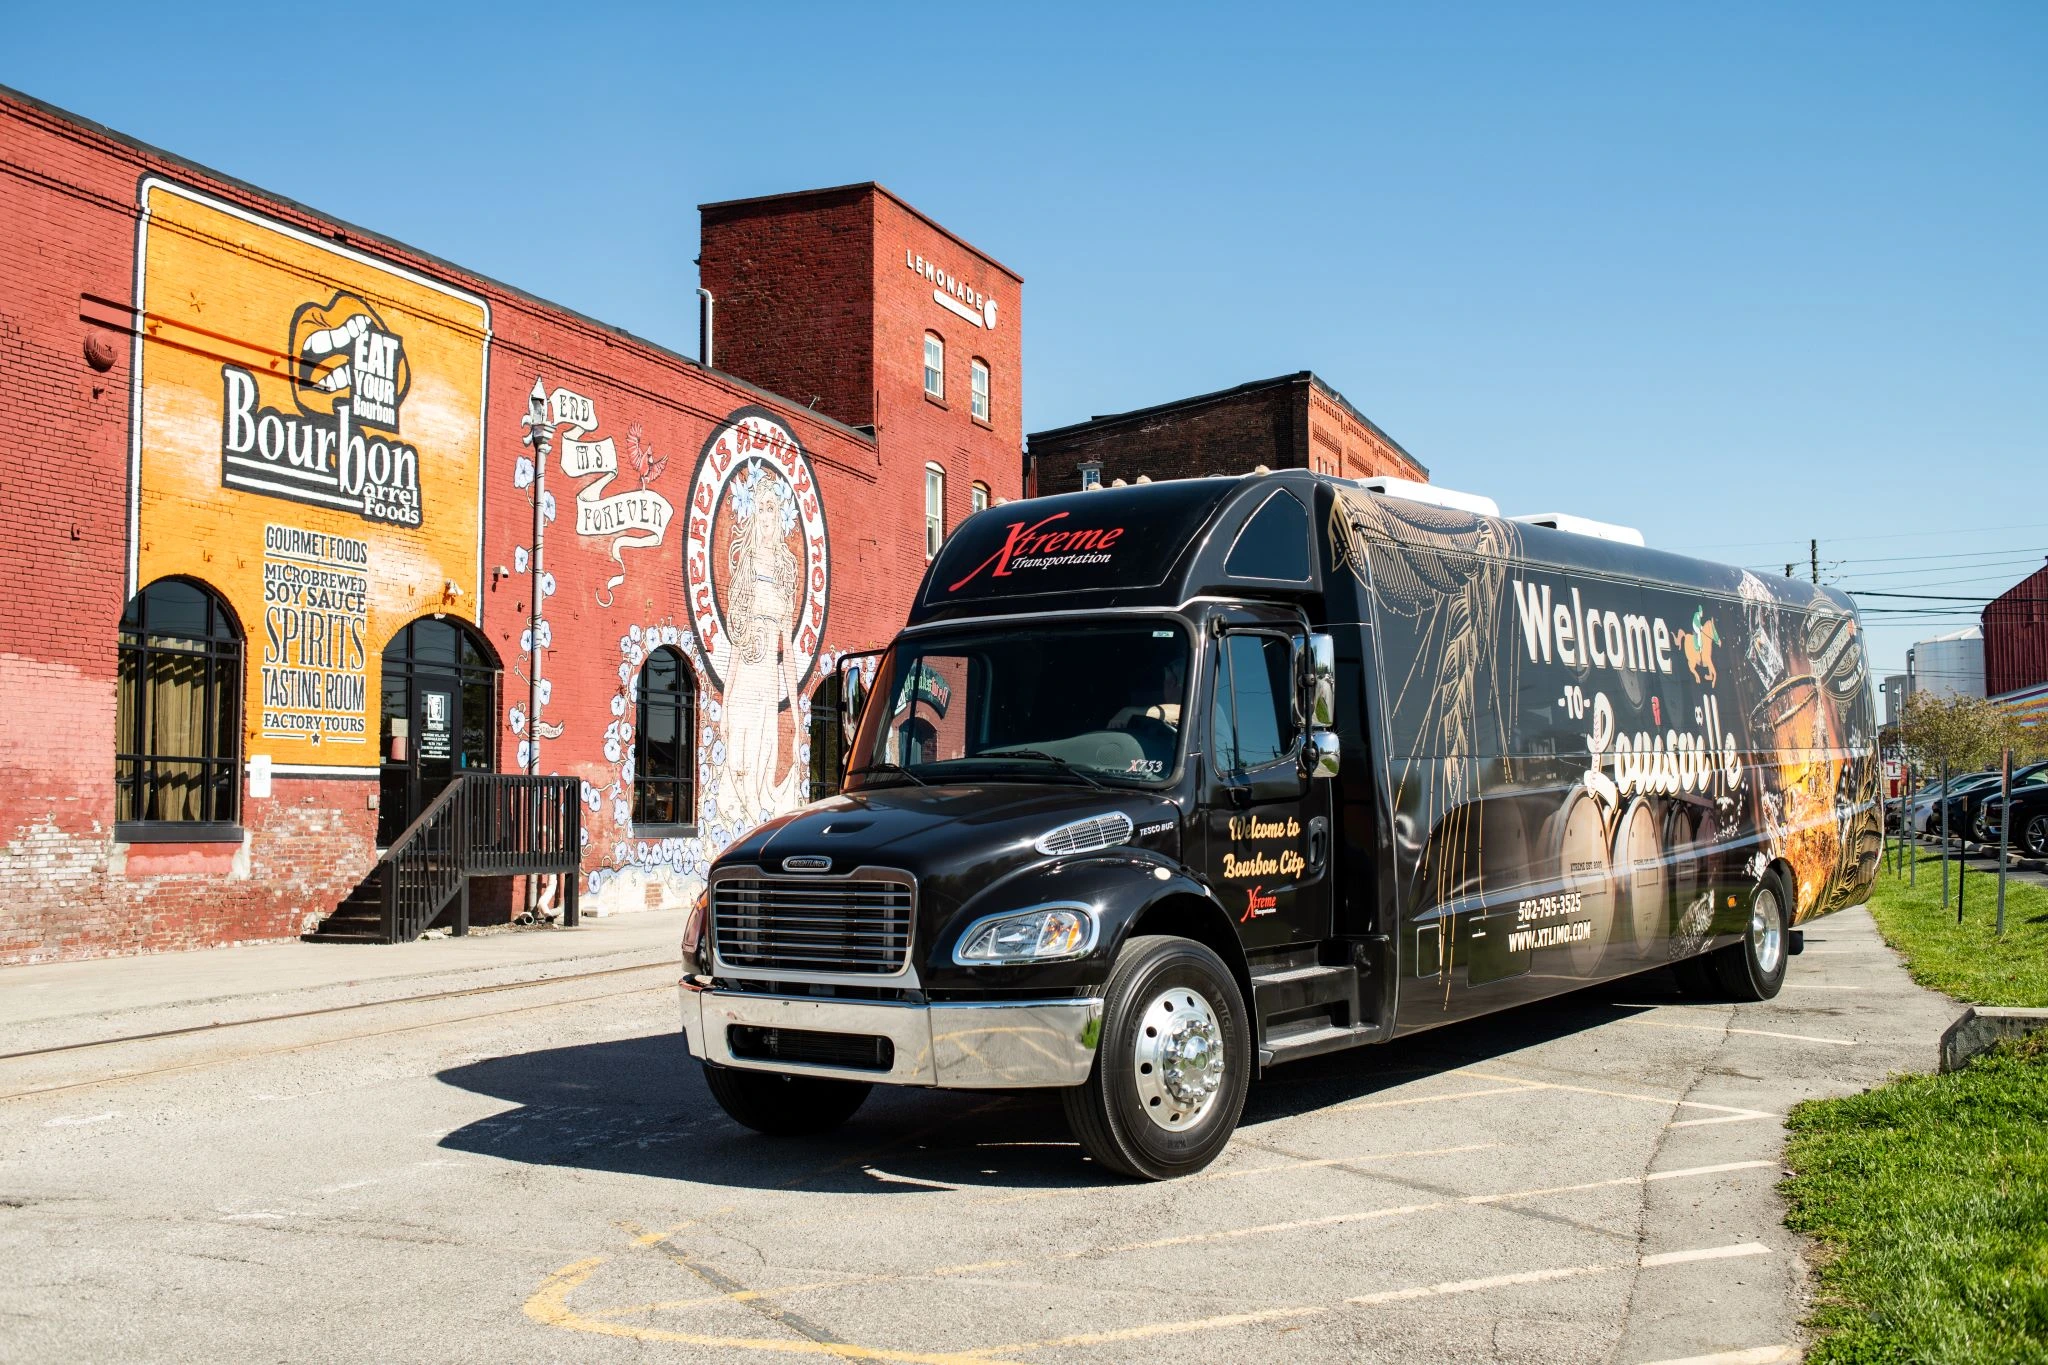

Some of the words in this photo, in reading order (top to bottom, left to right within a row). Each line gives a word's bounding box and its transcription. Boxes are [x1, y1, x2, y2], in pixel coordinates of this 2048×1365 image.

[906, 249, 983, 311] LEMONADE
[354, 330, 399, 381] EAT
[354, 369, 395, 406] YOUR
[354, 395, 395, 425] Bourbon
[560, 395, 590, 422] END
[224, 368, 418, 495] Bourbon
[709, 437, 732, 481] IS
[364, 497, 420, 525] Foods
[584, 499, 662, 531] FOREVER
[266, 525, 326, 557] GOURMET
[329, 536, 368, 564] FOODS
[948, 511, 1124, 592] Xtreme
[1011, 551, 1112, 570] Transportation
[264, 563, 367, 593] MICROBREWED
[265, 580, 303, 605] SOY
[307, 586, 366, 614] SAUCE
[265, 606, 365, 670] SPIRITS
[1512, 580, 1673, 674] Welcome
[262, 668, 321, 709] TASTING
[325, 673, 365, 711] ROOM
[264, 713, 322, 730] FACTORY
[324, 717, 364, 732] TOURS
[1126, 759, 1163, 773] X753
[1584, 692, 1744, 815] Louisville
[1140, 824, 1161, 837] TESCO
[1161, 821, 1174, 832] BUS
[1229, 815, 1286, 840] Welcome
[1287, 816, 1301, 837] to
[1223, 852, 1278, 879] Bourbon
[1280, 850, 1305, 879] City
[1240, 885, 1277, 923] Xtreme
[1517, 892, 1582, 922] 502-795-3525
[1508, 919, 1592, 953] WWW.XTLIMO.COM
